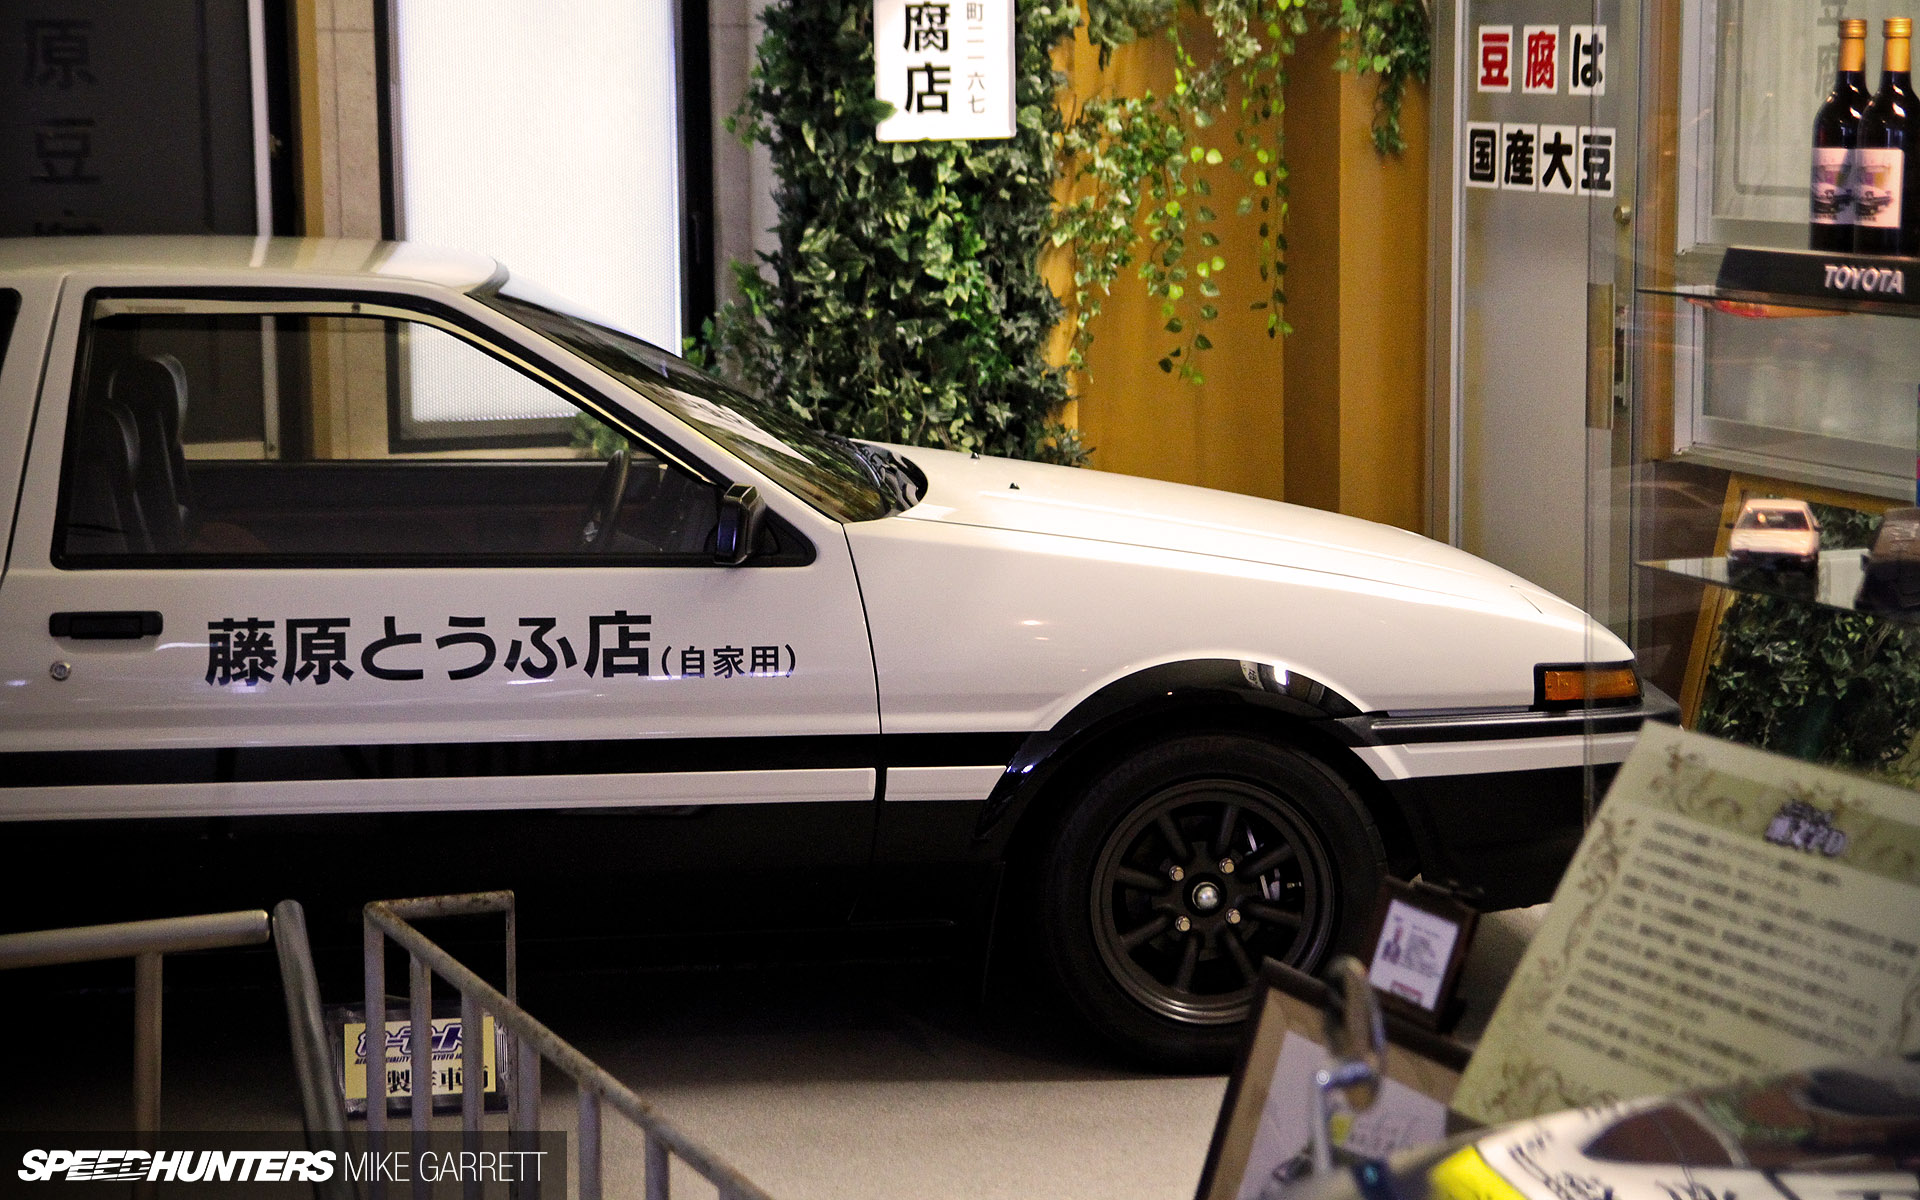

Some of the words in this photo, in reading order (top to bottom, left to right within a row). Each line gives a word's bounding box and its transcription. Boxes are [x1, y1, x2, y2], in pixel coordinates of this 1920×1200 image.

[903, 1, 952, 114] 腐店
[1480, 30, 1604, 89] 豆腐は
[1469, 127, 1613, 192] 国産大豆
[1824, 265, 1904, 293] TOYOTA
